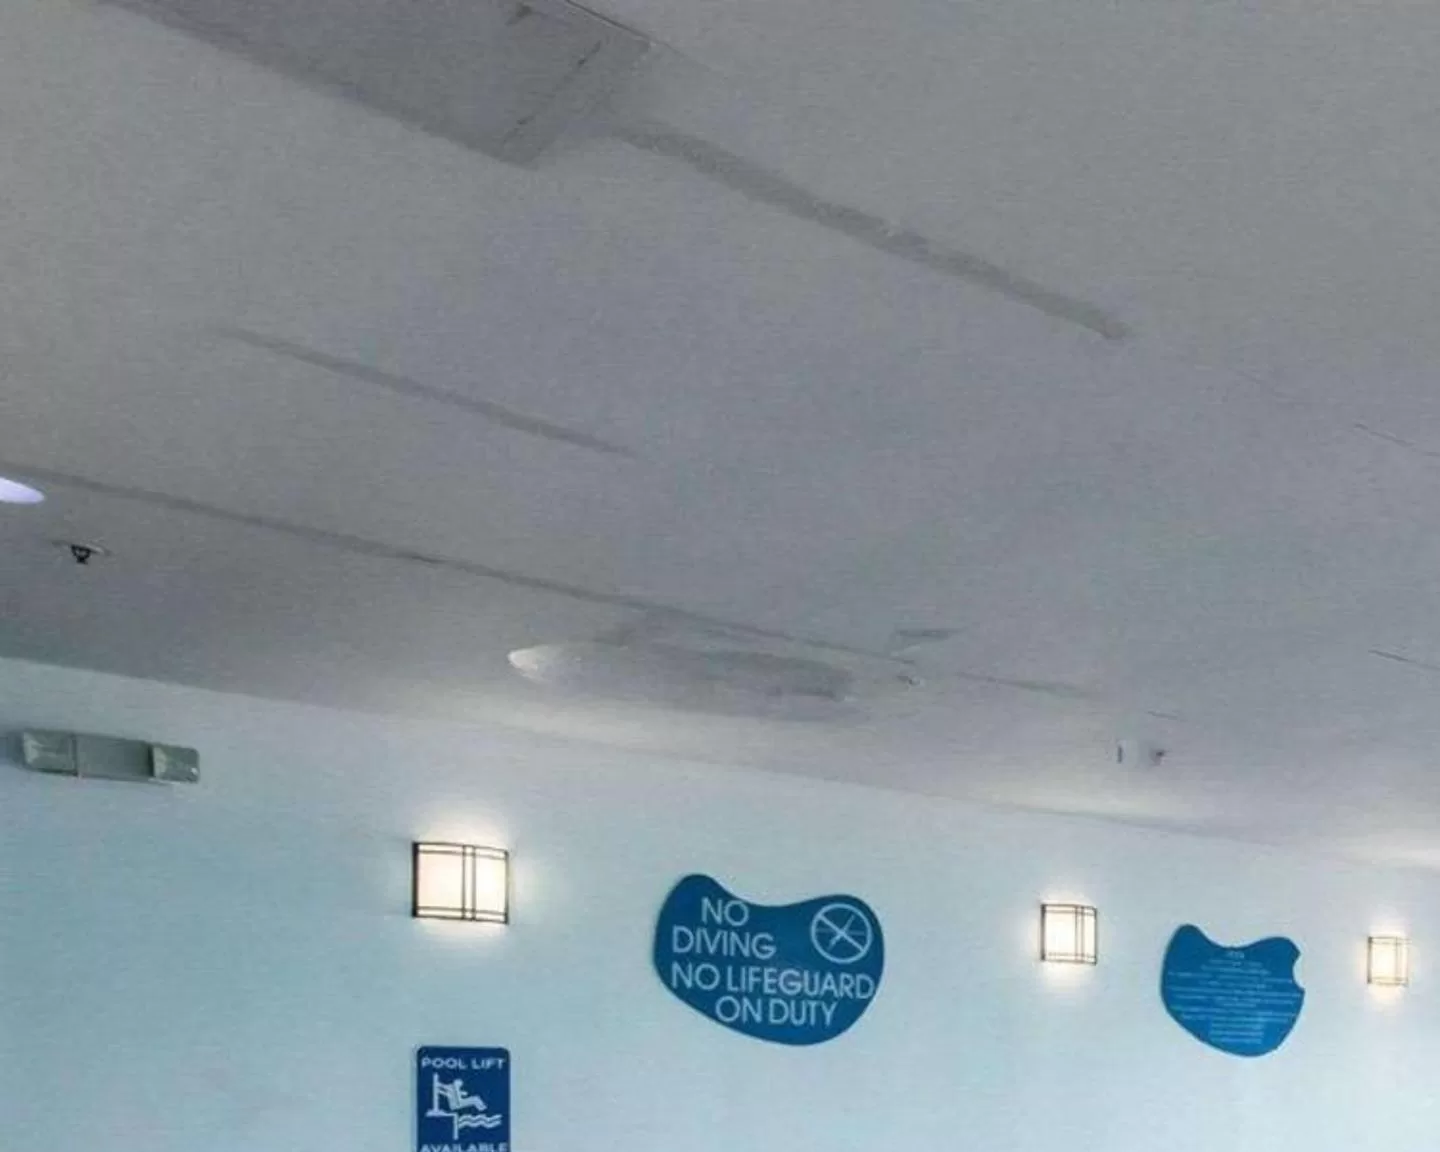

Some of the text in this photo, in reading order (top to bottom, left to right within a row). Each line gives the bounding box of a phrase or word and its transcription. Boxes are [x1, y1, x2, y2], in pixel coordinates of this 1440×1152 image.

[701, 897, 749, 926] NO
[672, 925, 776, 960] DIVING
[671, 960, 875, 1000] NO LIFEGUARD
[715, 995, 838, 1027] ON DUTY
[421, 1056, 504, 1070] POOL LIFT
